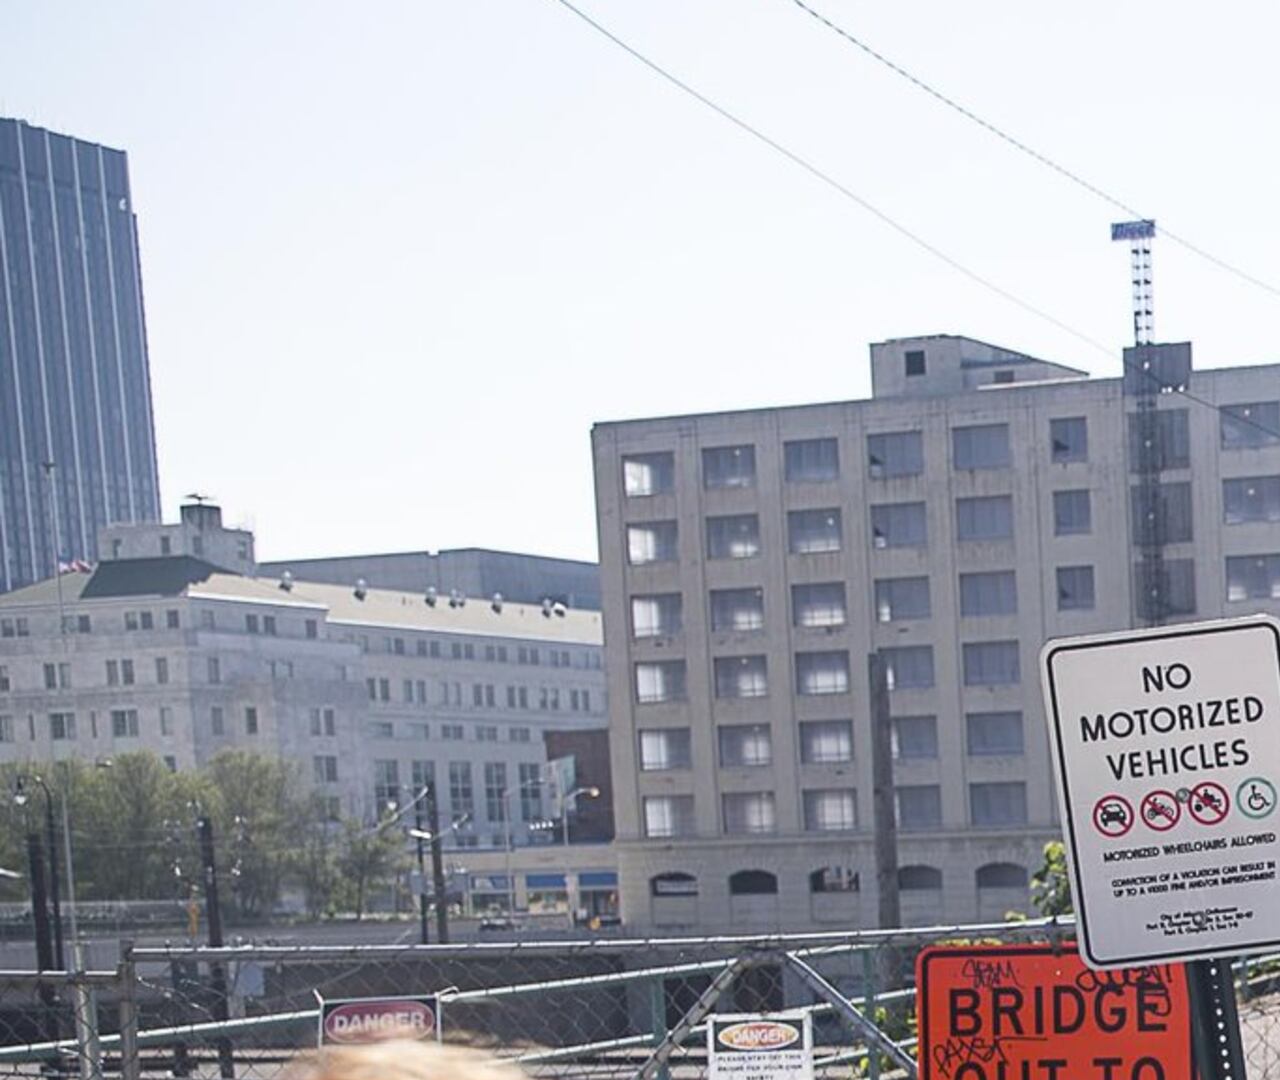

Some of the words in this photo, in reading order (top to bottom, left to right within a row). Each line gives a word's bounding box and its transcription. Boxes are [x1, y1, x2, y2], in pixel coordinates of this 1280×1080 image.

[1142, 663, 1191, 693] NO
[1080, 696, 1263, 742] MOTORIZED
[1106, 739, 1249, 780] VEHICLES
[1103, 847, 1159, 862] MOTORIZED
[1162, 838, 1227, 855] WHEELCHAIRS
[1231, 833, 1276, 847] ALLOWED
[1112, 875, 1157, 888] CONVICTION
[1159, 873, 1171, 882] OF
[1181, 868, 1220, 880] VIOLATION
[1222, 865, 1237, 875] CAN
[1113, 889, 1124, 898] UP
[1126, 888, 1137, 896] TO
[1139, 887, 1146, 895] A
[1189, 879, 1219, 890] AND/OR
[334, 1011, 425, 1032] DANGER
[949, 985, 1167, 1037] BRIDGE
[732, 1027, 788, 1046] DANGER
